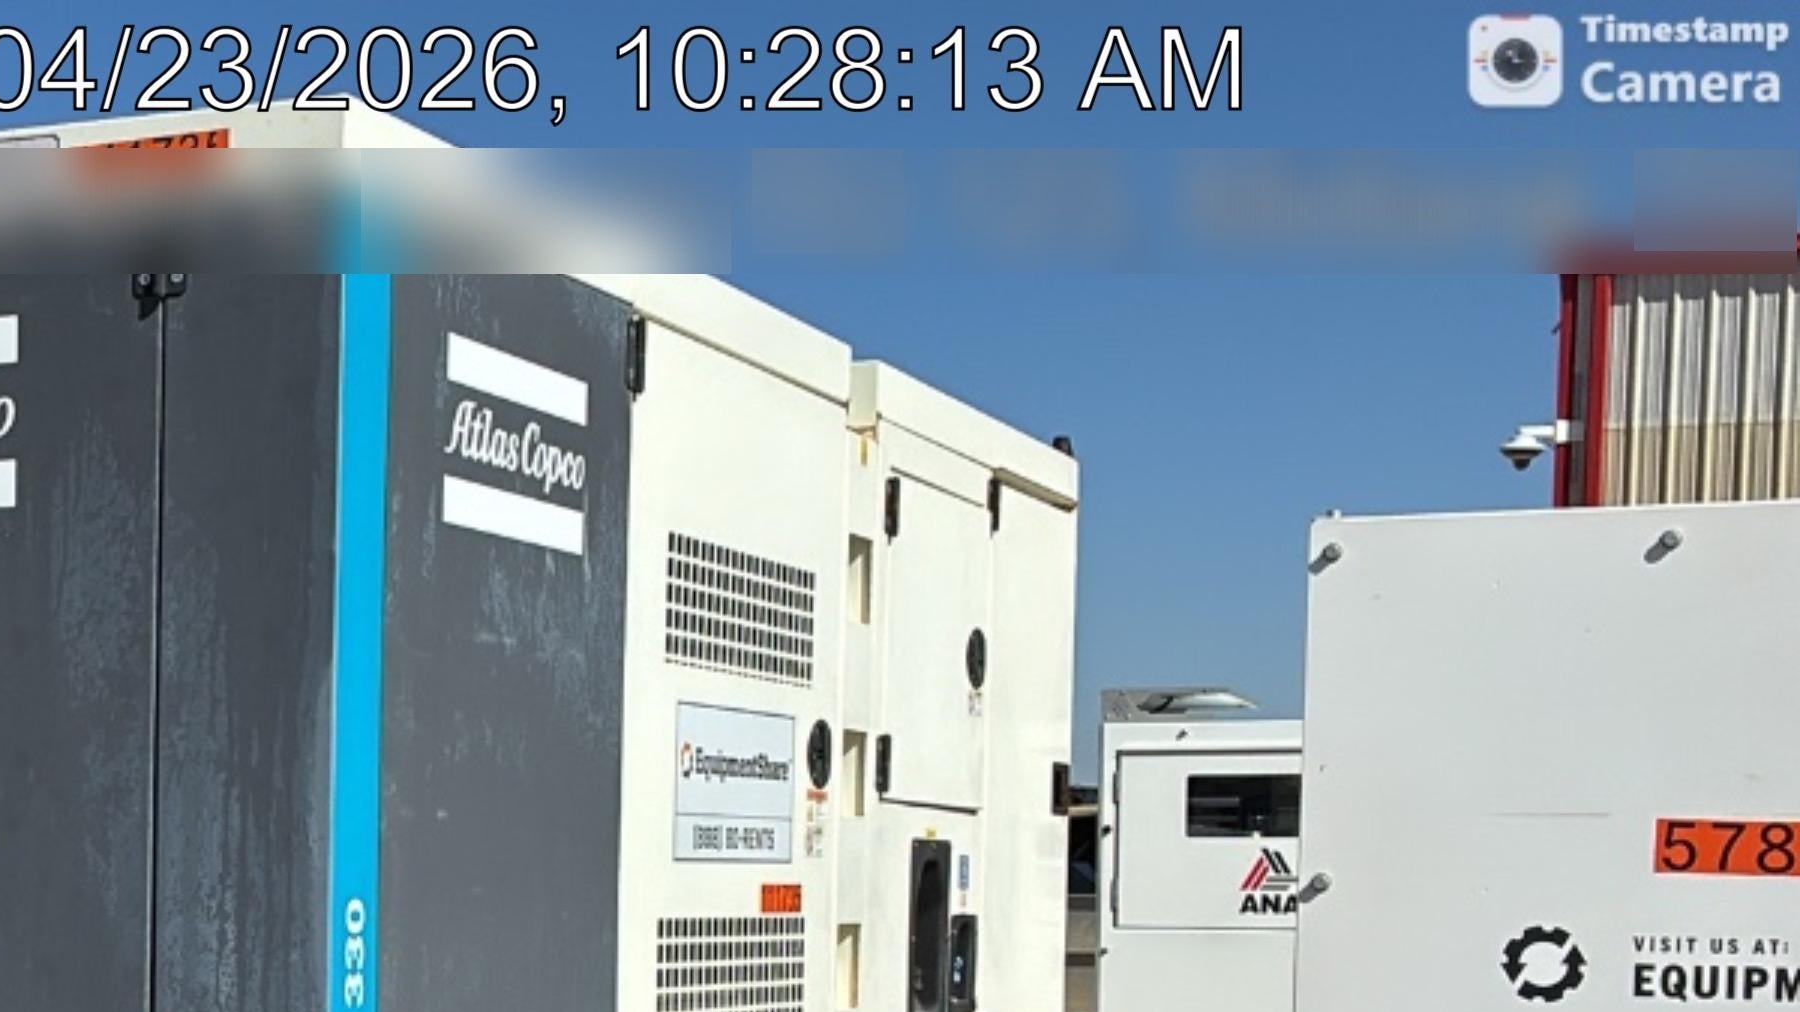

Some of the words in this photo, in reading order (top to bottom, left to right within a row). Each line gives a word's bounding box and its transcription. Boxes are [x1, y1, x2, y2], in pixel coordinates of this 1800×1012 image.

[443, 399, 520, 473] Atlas
[521, 421, 586, 495] Copco
[1660, 821, 1796, 875] 578
[343, 898, 366, 1009] 330
[1632, 936, 1698, 953] VISIT
[1709, 938, 1739, 955] US
[1752, 938, 1789, 956] AT:
